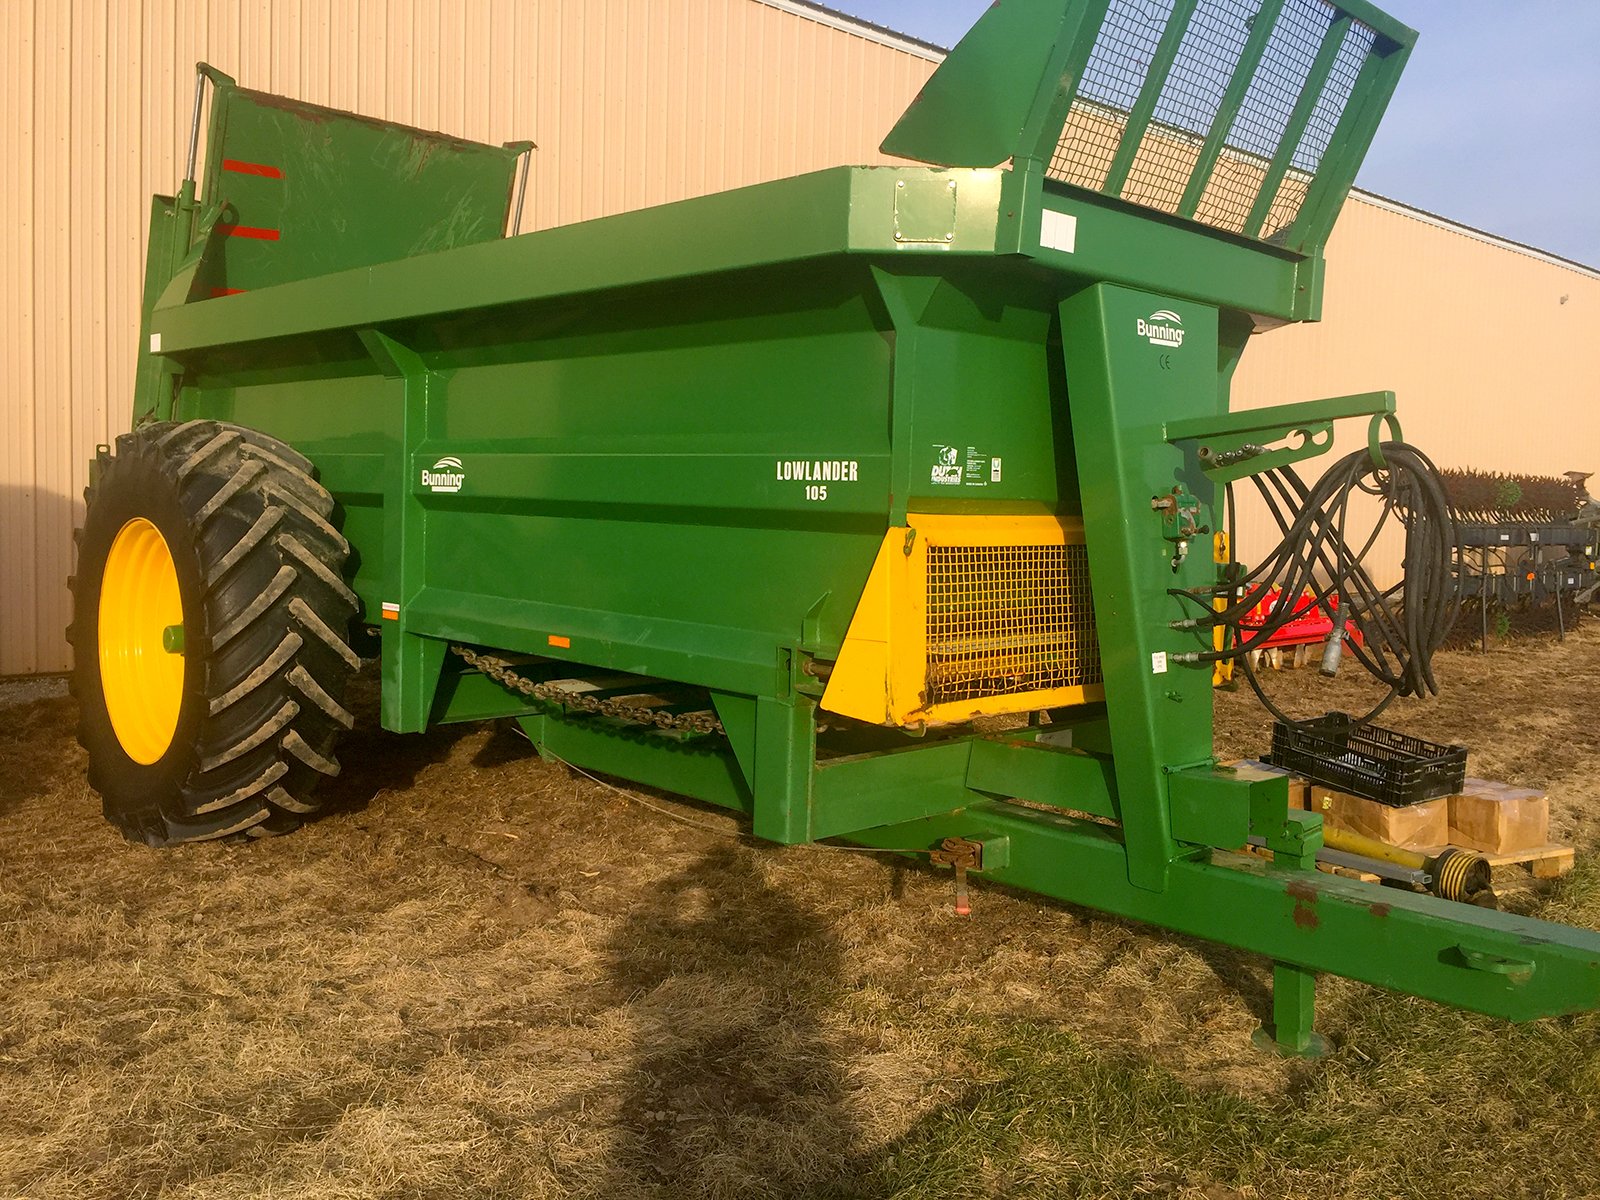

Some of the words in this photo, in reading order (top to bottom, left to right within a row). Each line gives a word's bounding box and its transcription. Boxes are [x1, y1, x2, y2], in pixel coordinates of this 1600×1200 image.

[1137, 318, 1183, 346] Bunning
[421, 469, 463, 490] Bunning
[776, 460, 859, 482] LOWLANDER
[805, 484, 828, 501] 105
